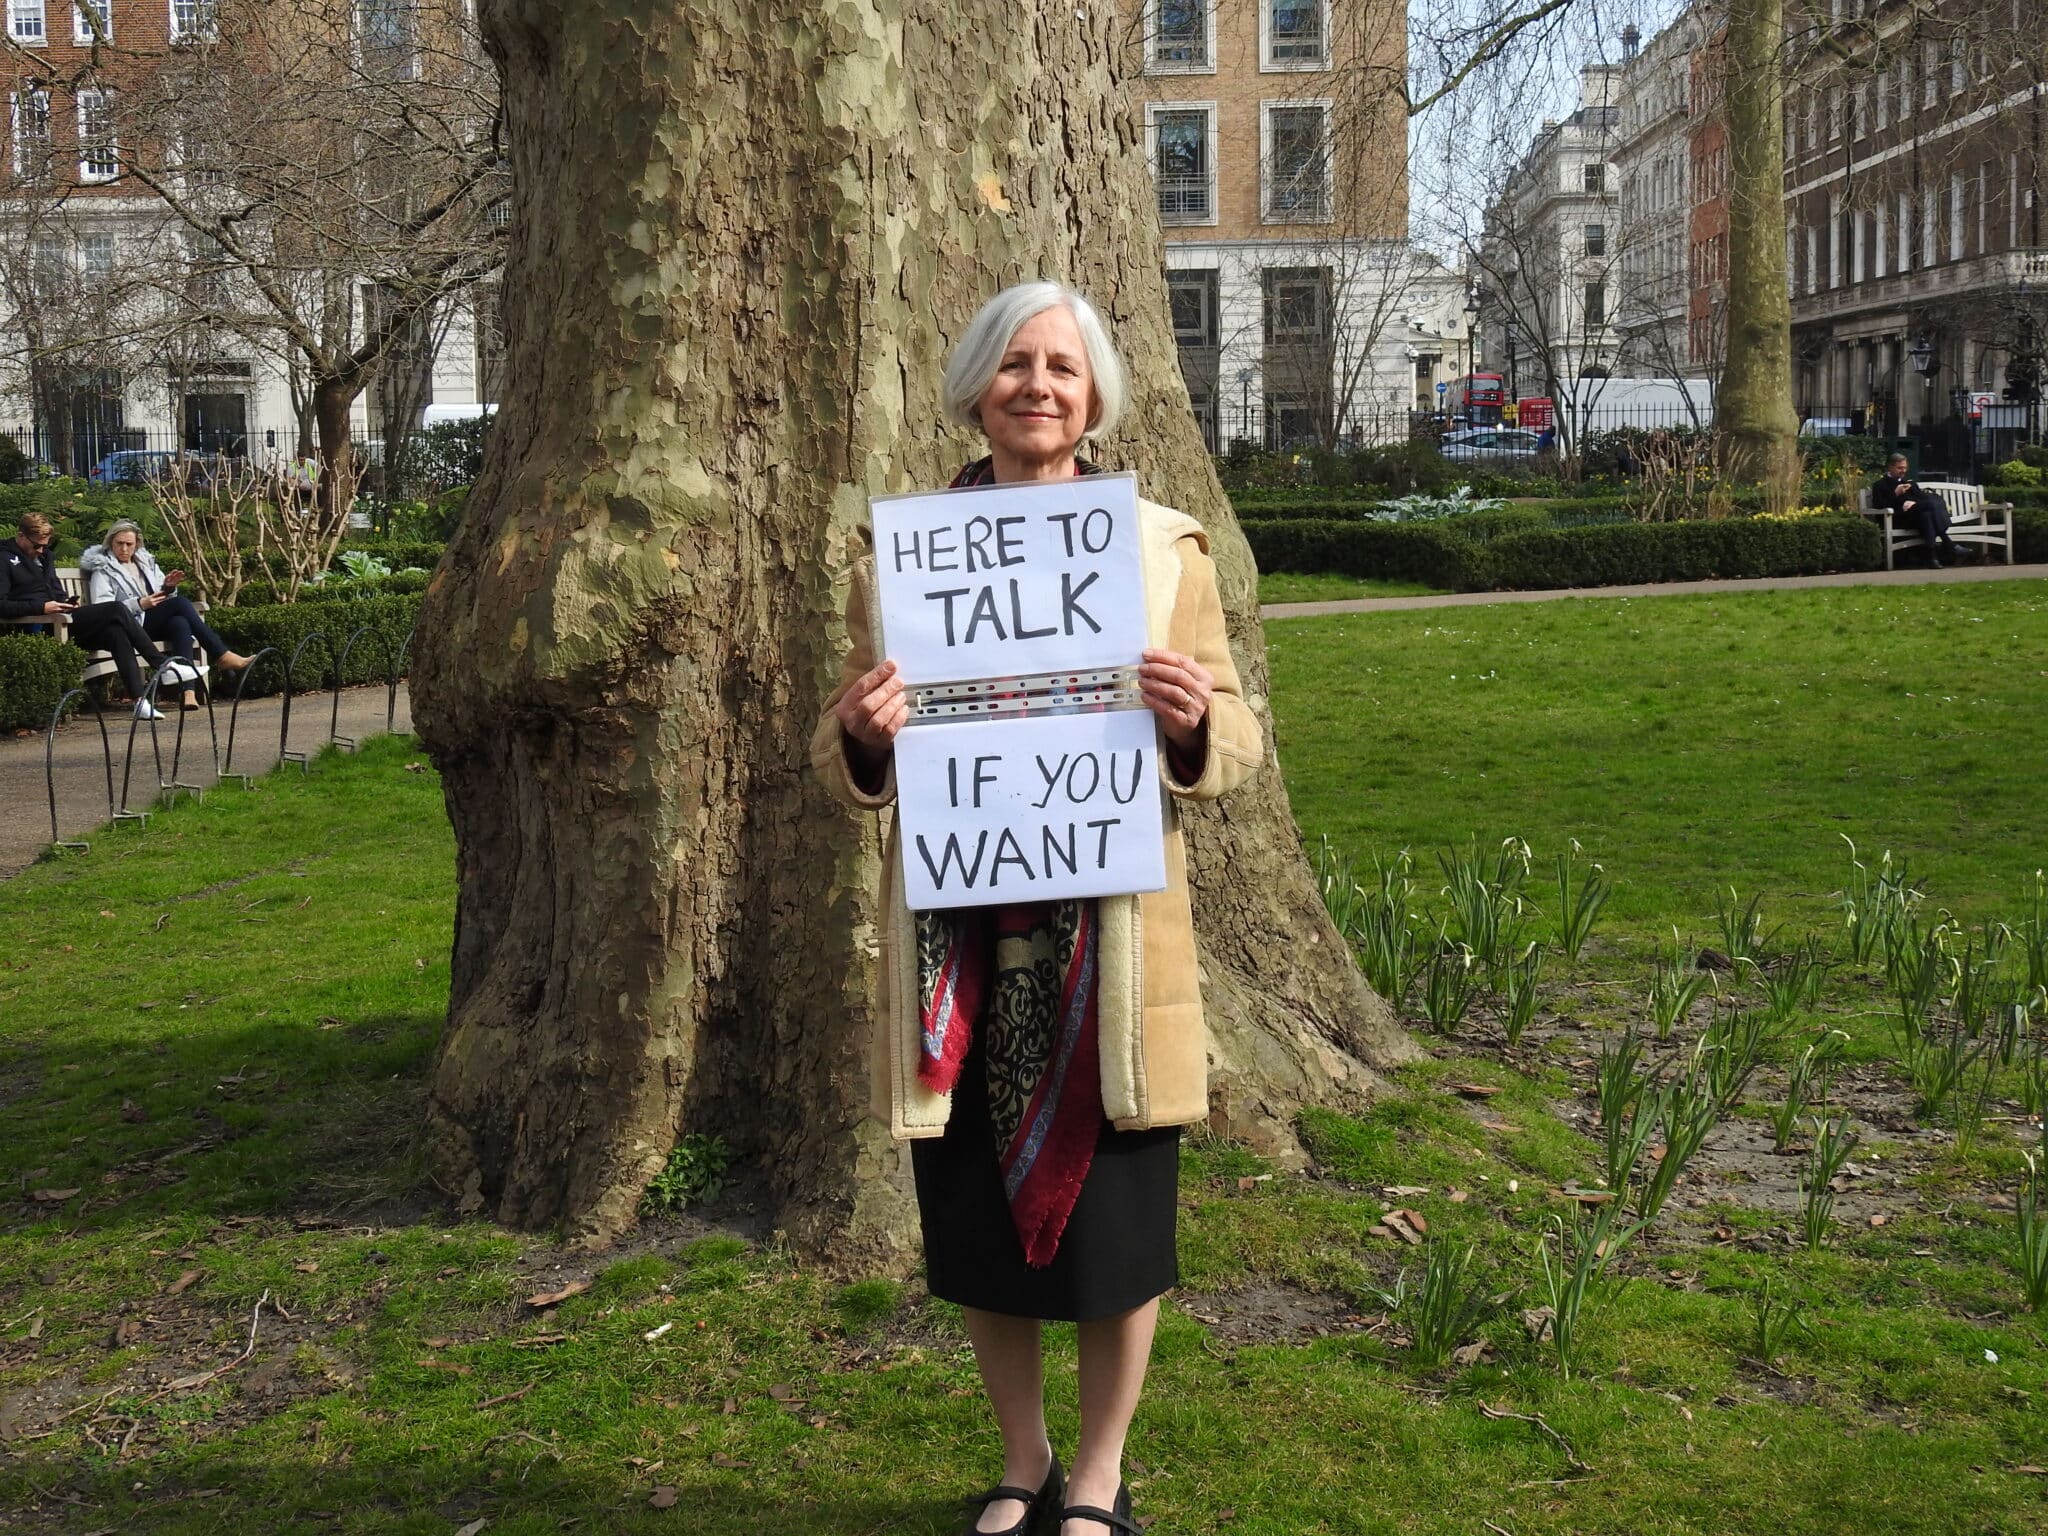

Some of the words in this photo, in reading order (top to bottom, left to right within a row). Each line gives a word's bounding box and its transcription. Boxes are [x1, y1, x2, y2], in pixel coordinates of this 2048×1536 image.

[893, 515, 1026, 574] HERE
[1046, 508, 1113, 558] TO
[924, 571, 1102, 647] TALK
[947, 755, 1003, 809] IF
[1030, 748, 1143, 809] YOU
[915, 818, 1121, 891] WANT
